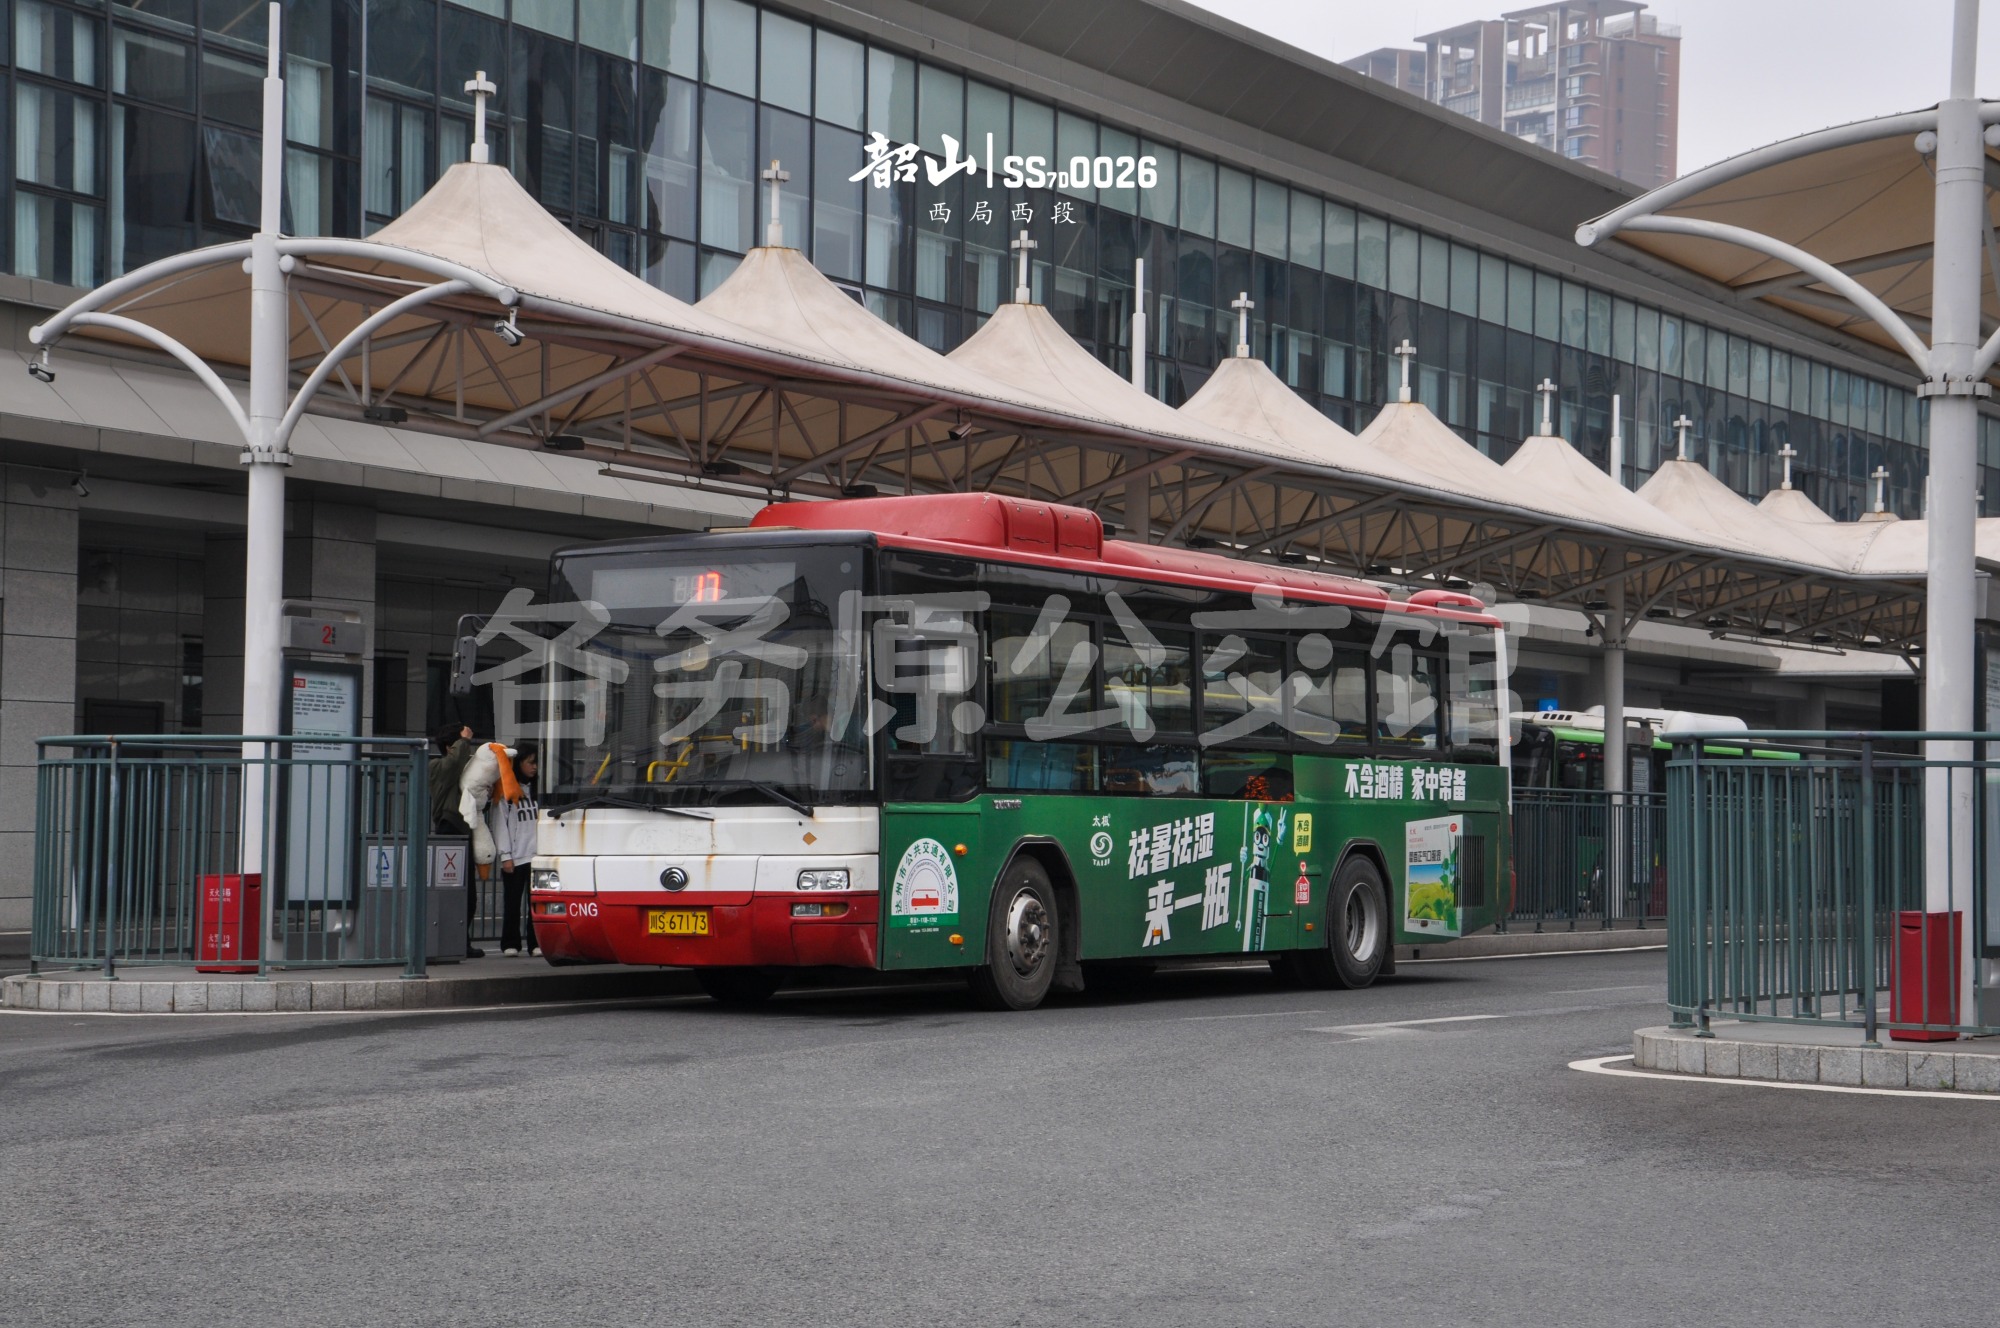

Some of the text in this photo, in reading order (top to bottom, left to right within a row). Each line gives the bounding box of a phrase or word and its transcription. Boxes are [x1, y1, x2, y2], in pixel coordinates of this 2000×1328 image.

[322, 625, 332, 644] 2
[1344, 763, 1466, 801] 不含酒精 家中常备
[1092, 815, 1110, 827] 太极
[1128, 812, 1215, 880] 祛暑祛湿
[1092, 858, 1110, 867] TAIJI
[569, 903, 598, 917] CNG
[1142, 862, 1233, 948] 来一瓶
